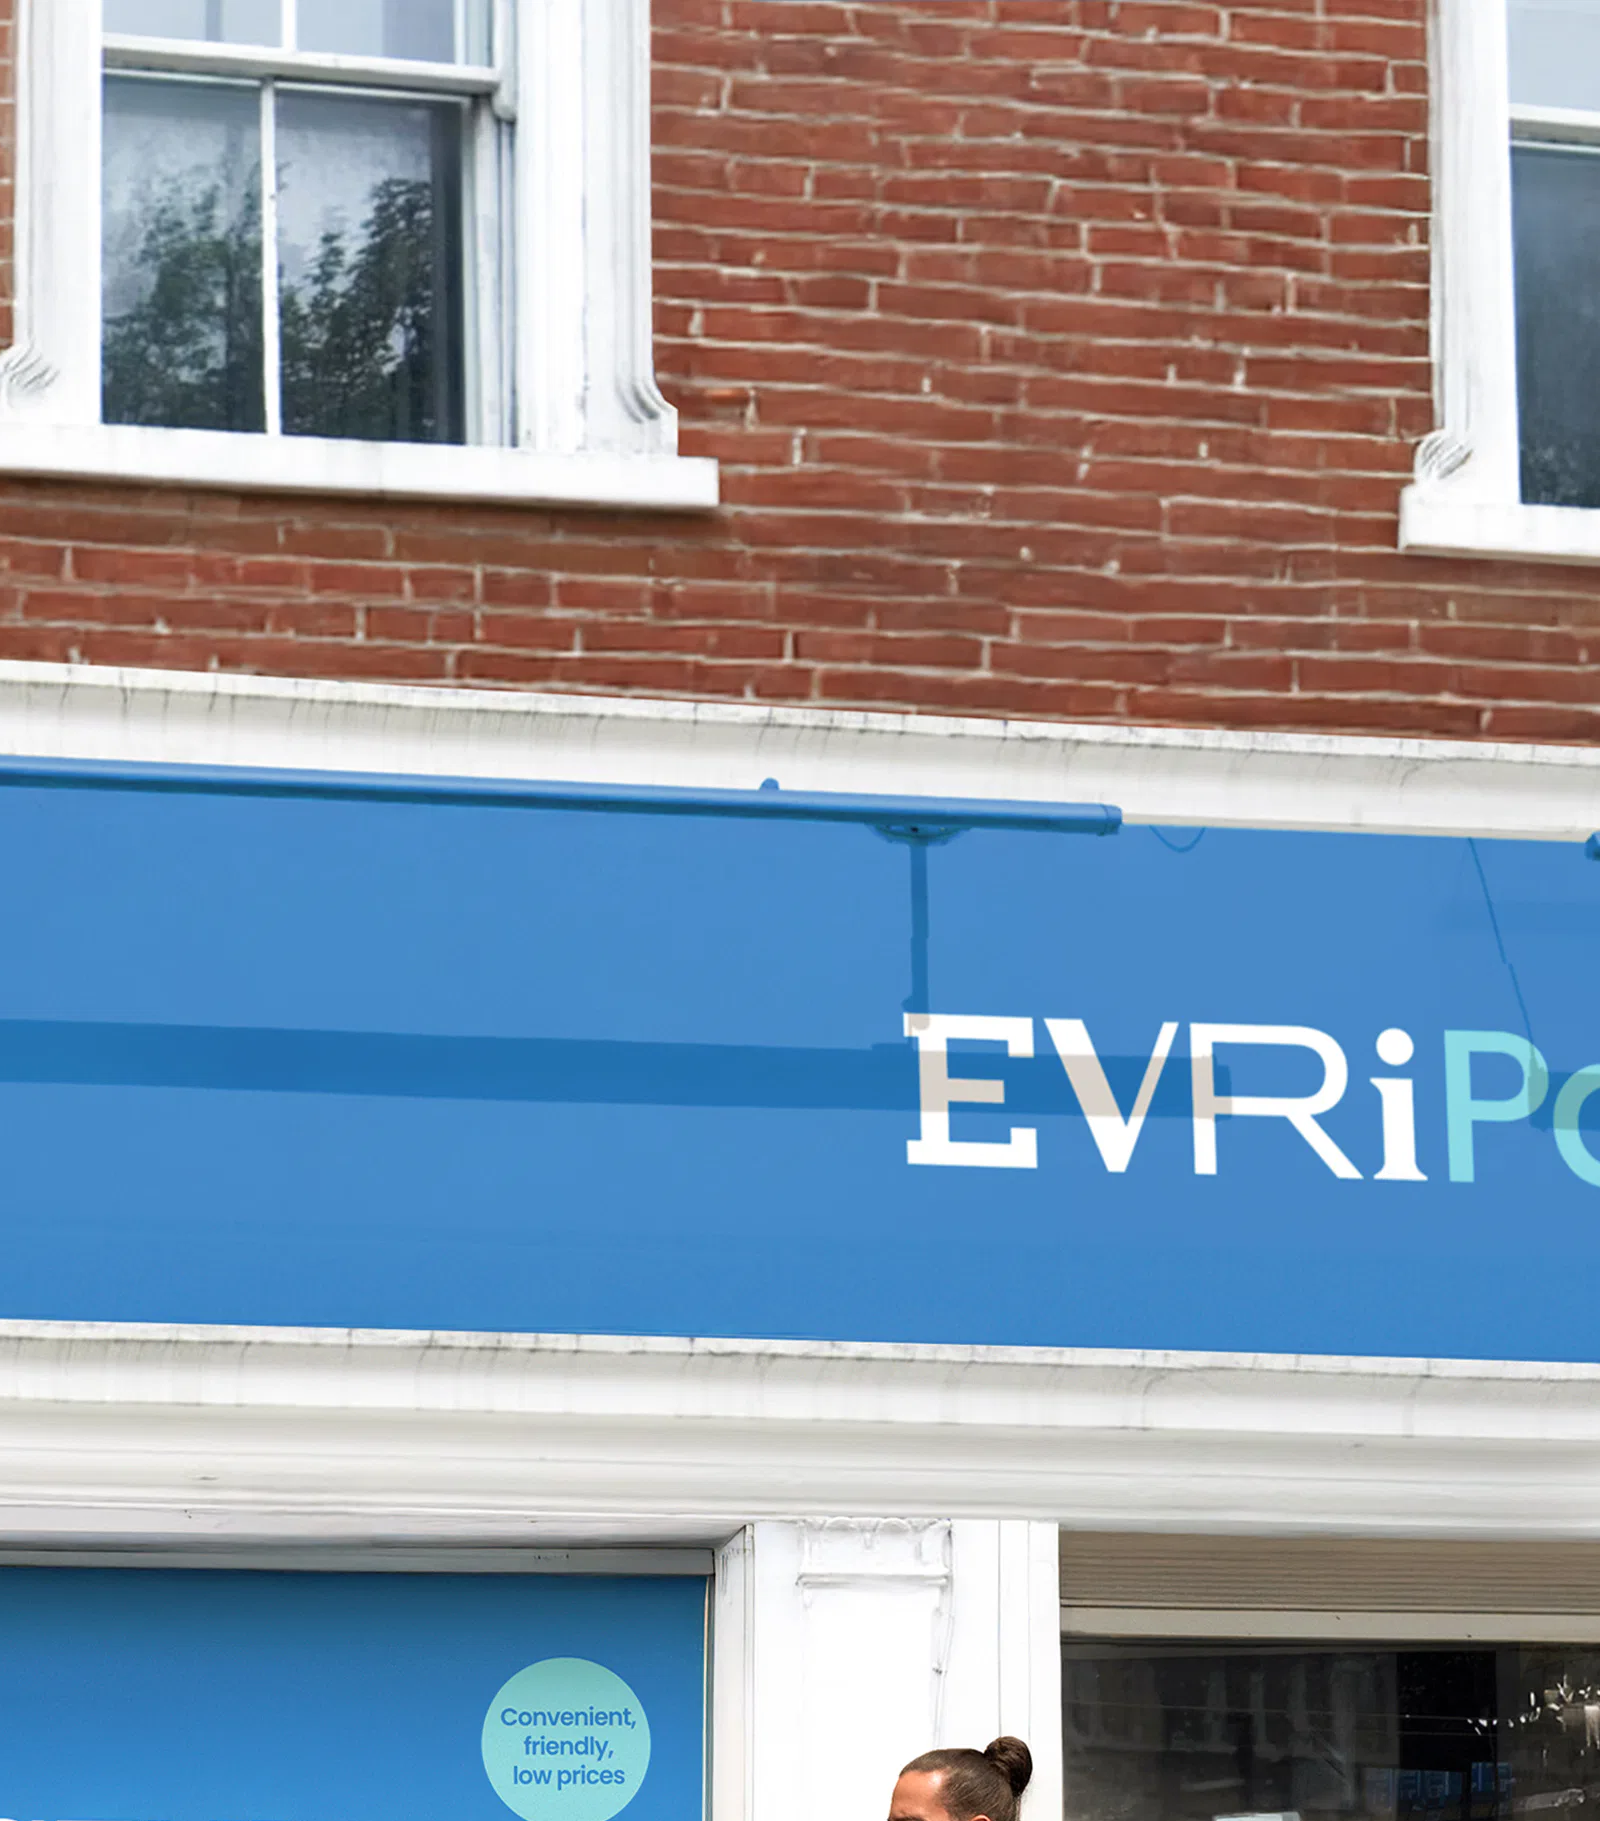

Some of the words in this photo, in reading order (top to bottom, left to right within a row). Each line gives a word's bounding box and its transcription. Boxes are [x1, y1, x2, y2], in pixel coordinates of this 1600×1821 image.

[500, 1706, 637, 1730] Convenient,
[523, 1735, 615, 1761] friendly,
[513, 1765, 552, 1785] low
[556, 1764, 626, 1791] prices
